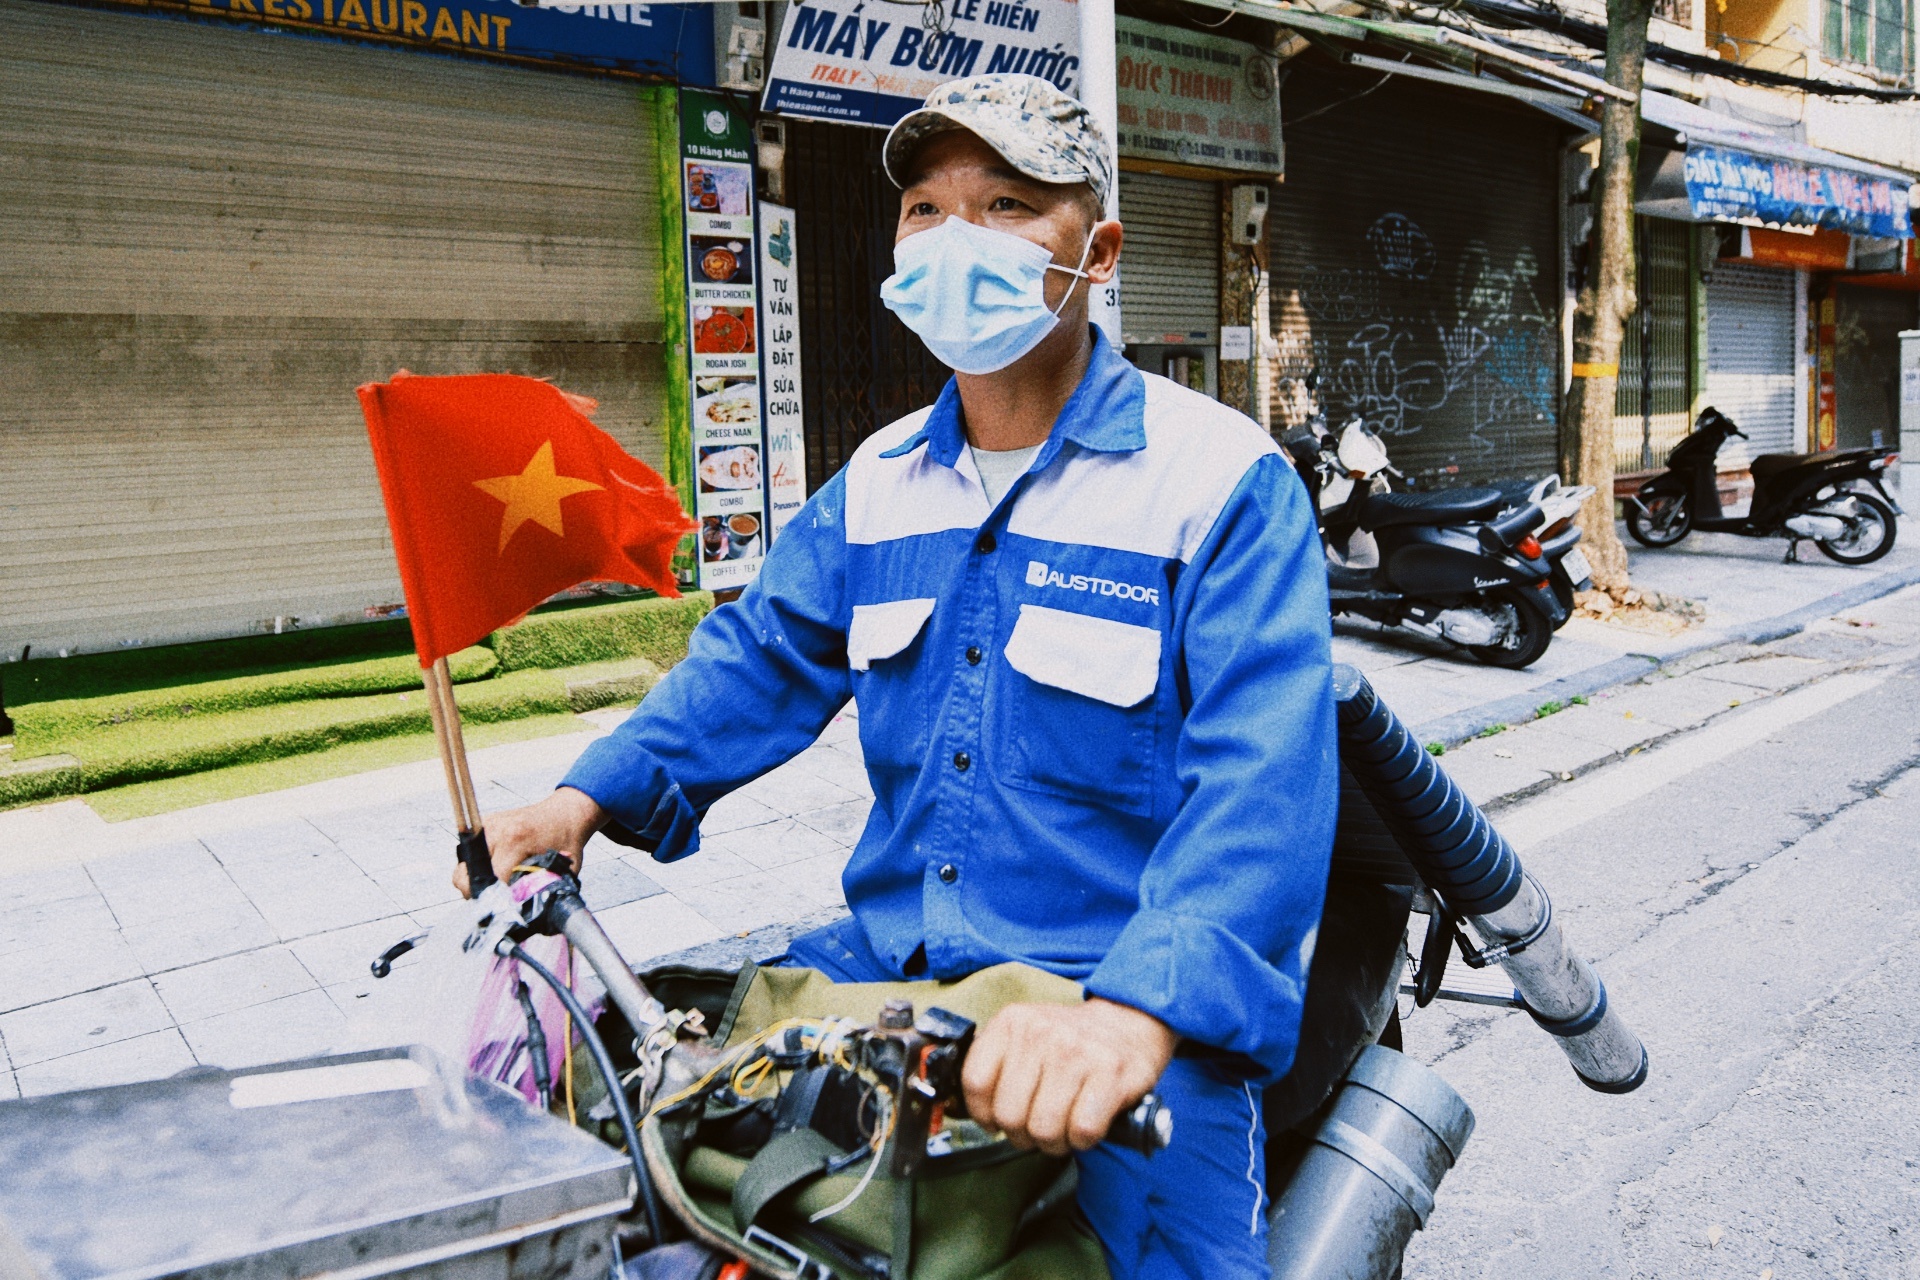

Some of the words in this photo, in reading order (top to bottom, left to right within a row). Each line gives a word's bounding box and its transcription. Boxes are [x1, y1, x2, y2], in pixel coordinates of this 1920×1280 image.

[787, 3, 890, 61] MÁY
[890, 26, 983, 77] BƠM
[986, 42, 1080, 91] NƯỚC
[780, 85, 787, 94] 8
[789, 87, 814, 98] Hàng
[815, 90, 842, 102] Mành
[687, 144, 698, 155] 10
[700, 146, 722, 159] Hàng
[724, 148, 748, 160] Mành
[709, 219, 732, 230] COMBO
[695, 288, 721, 298] BUTTER
[722, 290, 751, 300] CHICKEN
[773, 278, 788, 293] TƯ
[770, 296, 793, 316] VẤN
[1105, 288, 1121, 307] 3
[773, 325, 792, 343] LẮP
[705, 359, 728, 369] ROGAN
[730, 358, 747, 368] JOSH
[772, 348, 794, 369] ĐẶT
[773, 375, 795, 394] SỬA
[770, 399, 800, 416] CHỮA
[705, 429, 731, 439] CHEESE
[733, 428, 752, 437] NAAN
[719, 497, 744, 507] COMBO
[712, 566, 737, 577] COFFEE
[744, 563, 756, 573] TEA
[1045, 570, 1160, 606] AUSTDOOR
